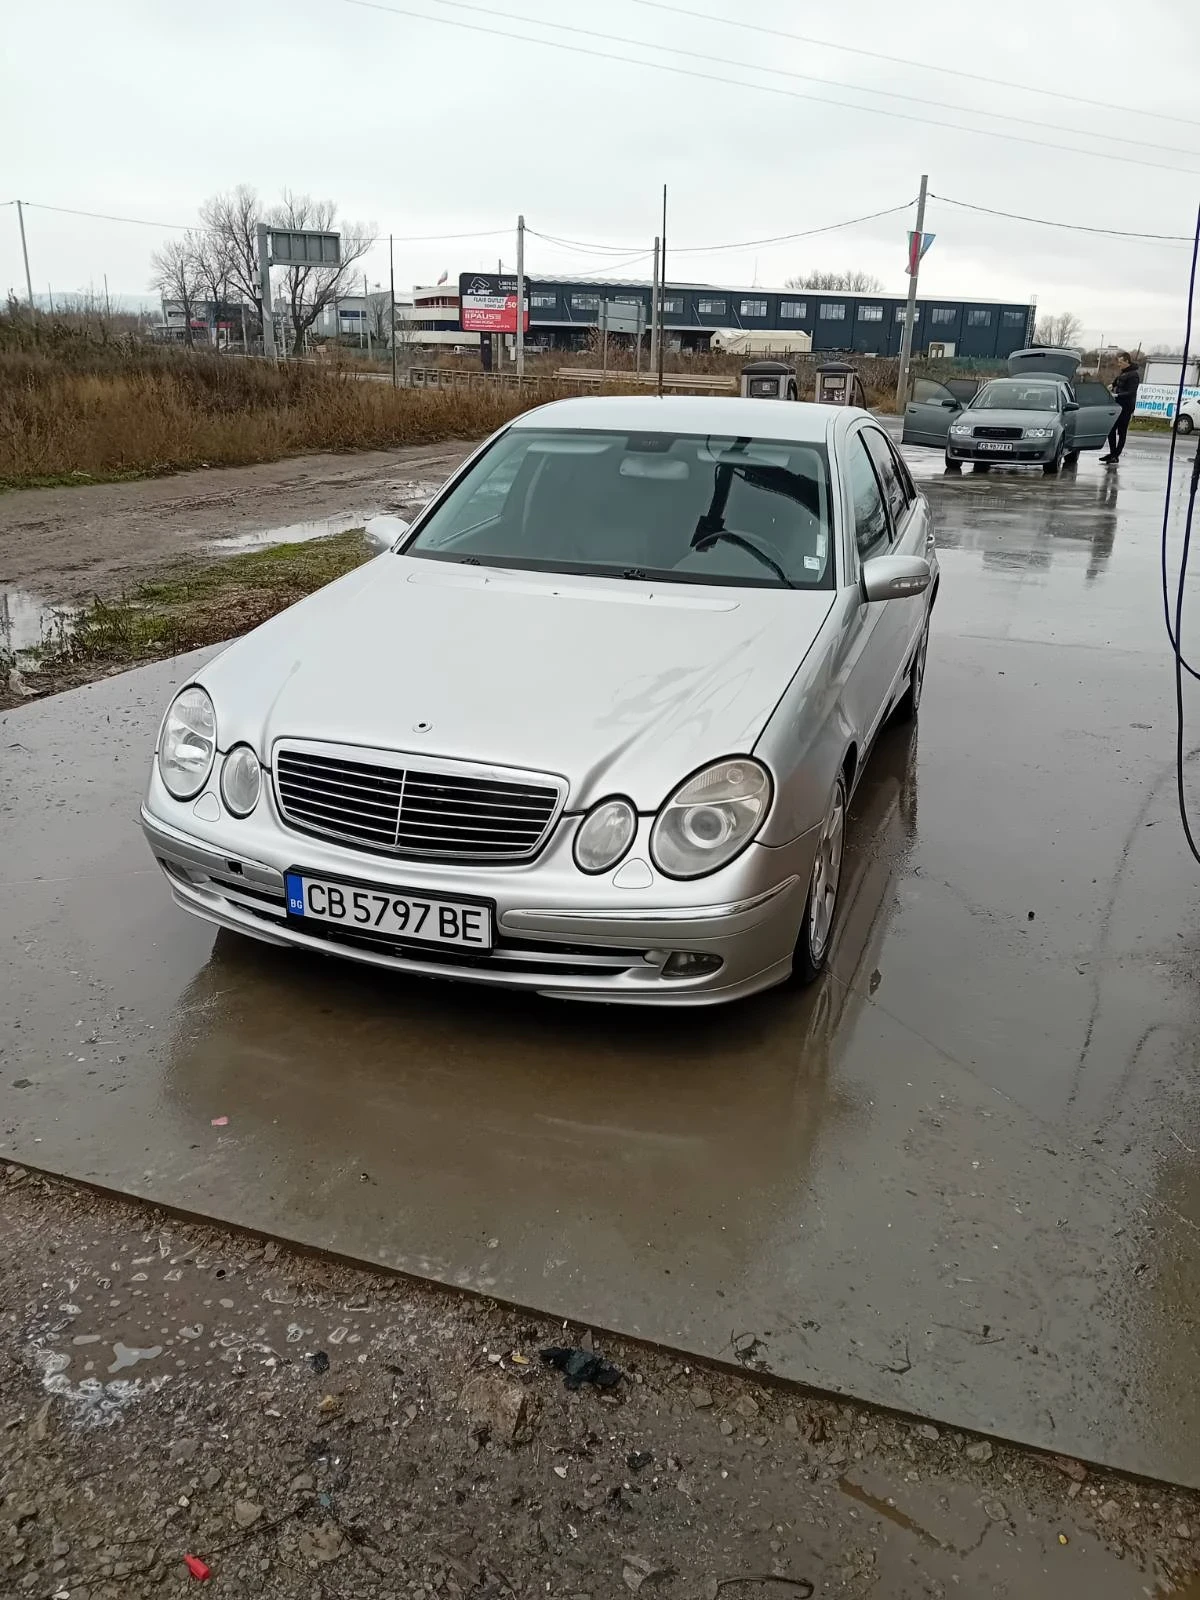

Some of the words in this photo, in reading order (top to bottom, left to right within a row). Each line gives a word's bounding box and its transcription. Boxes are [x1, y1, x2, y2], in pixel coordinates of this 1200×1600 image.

[290, 898, 303, 909] BG
[307, 884, 346, 918] CB
[353, 892, 431, 934] 5797
[439, 906, 482, 942] BE
